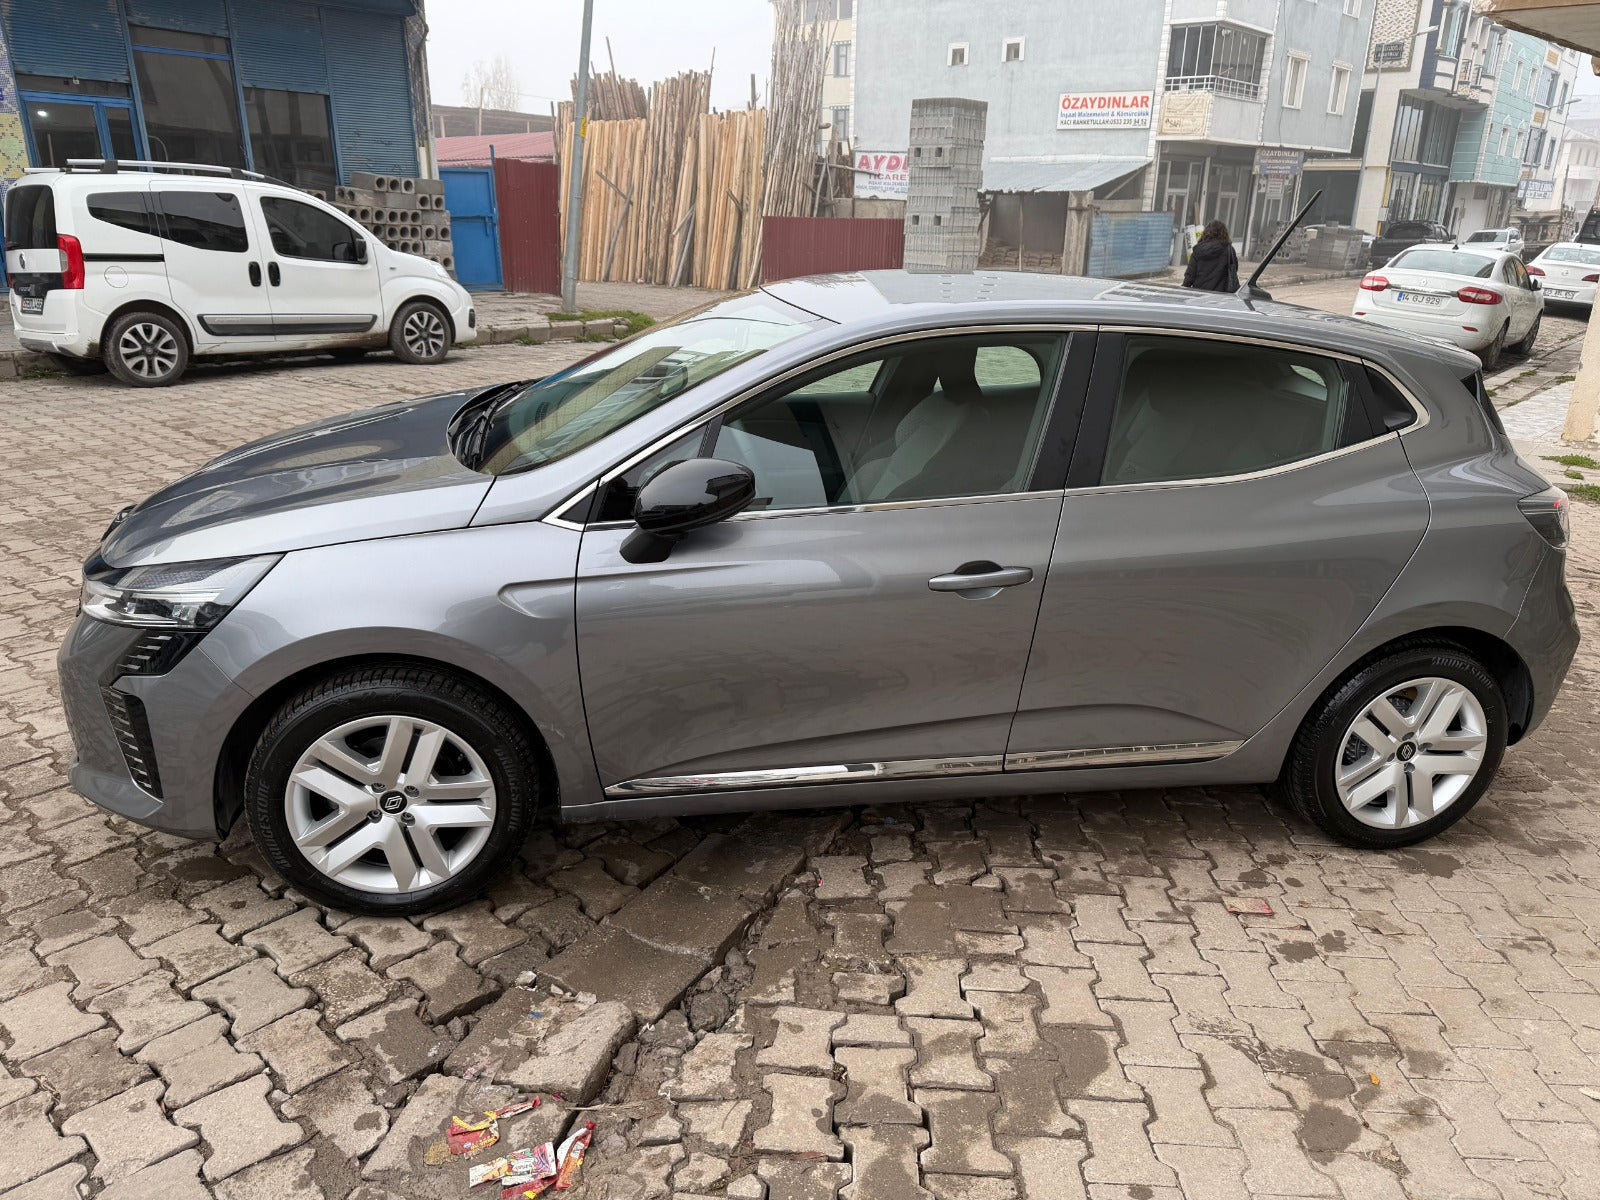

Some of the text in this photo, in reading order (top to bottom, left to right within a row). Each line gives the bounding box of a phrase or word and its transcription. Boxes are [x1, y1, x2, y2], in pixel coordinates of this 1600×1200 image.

[1061, 95, 1150, 110] ÖZAYDINLAR
[1402, 293, 1441, 305] 14 GJ 929
